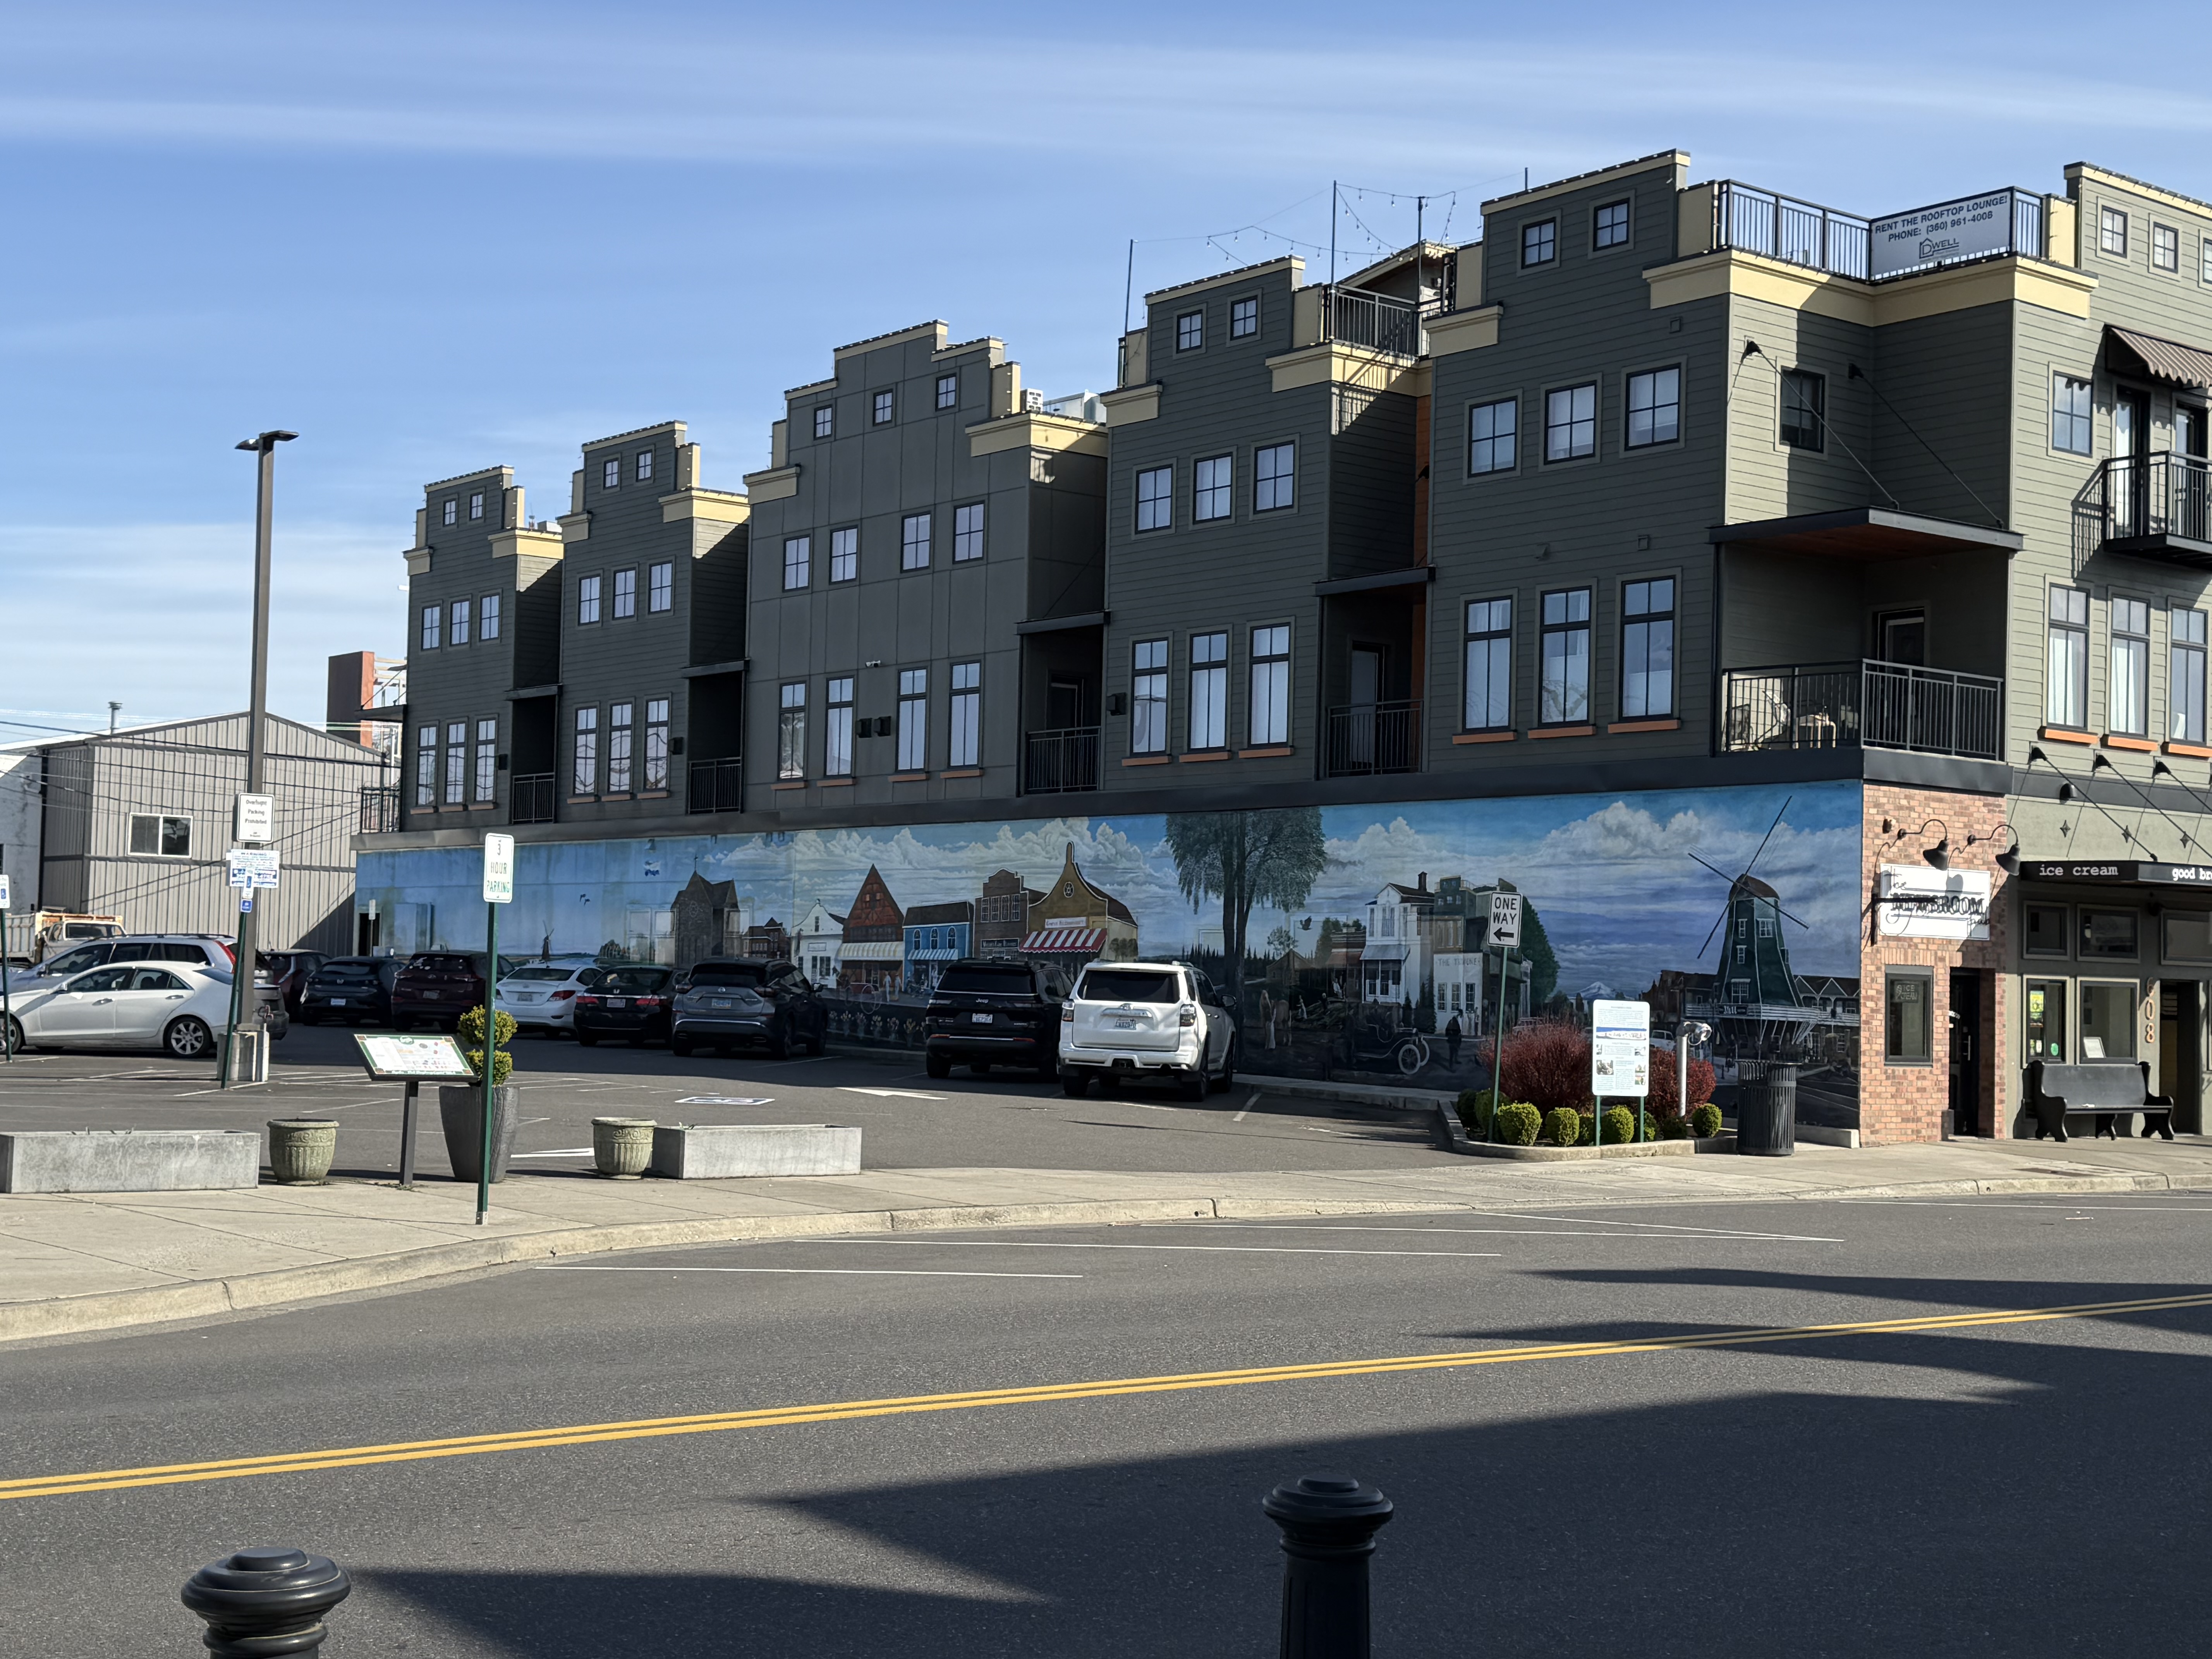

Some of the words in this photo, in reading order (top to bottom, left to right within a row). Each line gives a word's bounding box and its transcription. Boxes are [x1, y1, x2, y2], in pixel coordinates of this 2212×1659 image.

[1875, 221, 1899, 234] RENT
[1901, 217, 1918, 227] THE
[1921, 206, 1965, 223] ROOFTOP
[1966, 195, 2008, 213] LOUNGE!
[1888, 228, 1921, 242] PHONE:
[1926, 221, 1948, 235] (360)
[1951, 211, 1993, 227] 961-4008
[1922, 238, 1960, 255] DWELL
[497, 843, 501, 856] 3
[490, 862, 507, 874] HOUR
[2039, 864, 2064, 876] ice
[2073, 865, 2119, 876] cream
[2172, 867, 2195, 881] good
[2199, 867, 2212, 880] br
[486, 880, 510, 893] PARKING
[1494, 897, 1517, 910] ONE
[1493, 912, 1517, 925] WAY
[2145, 977, 2155, 1044] 608
